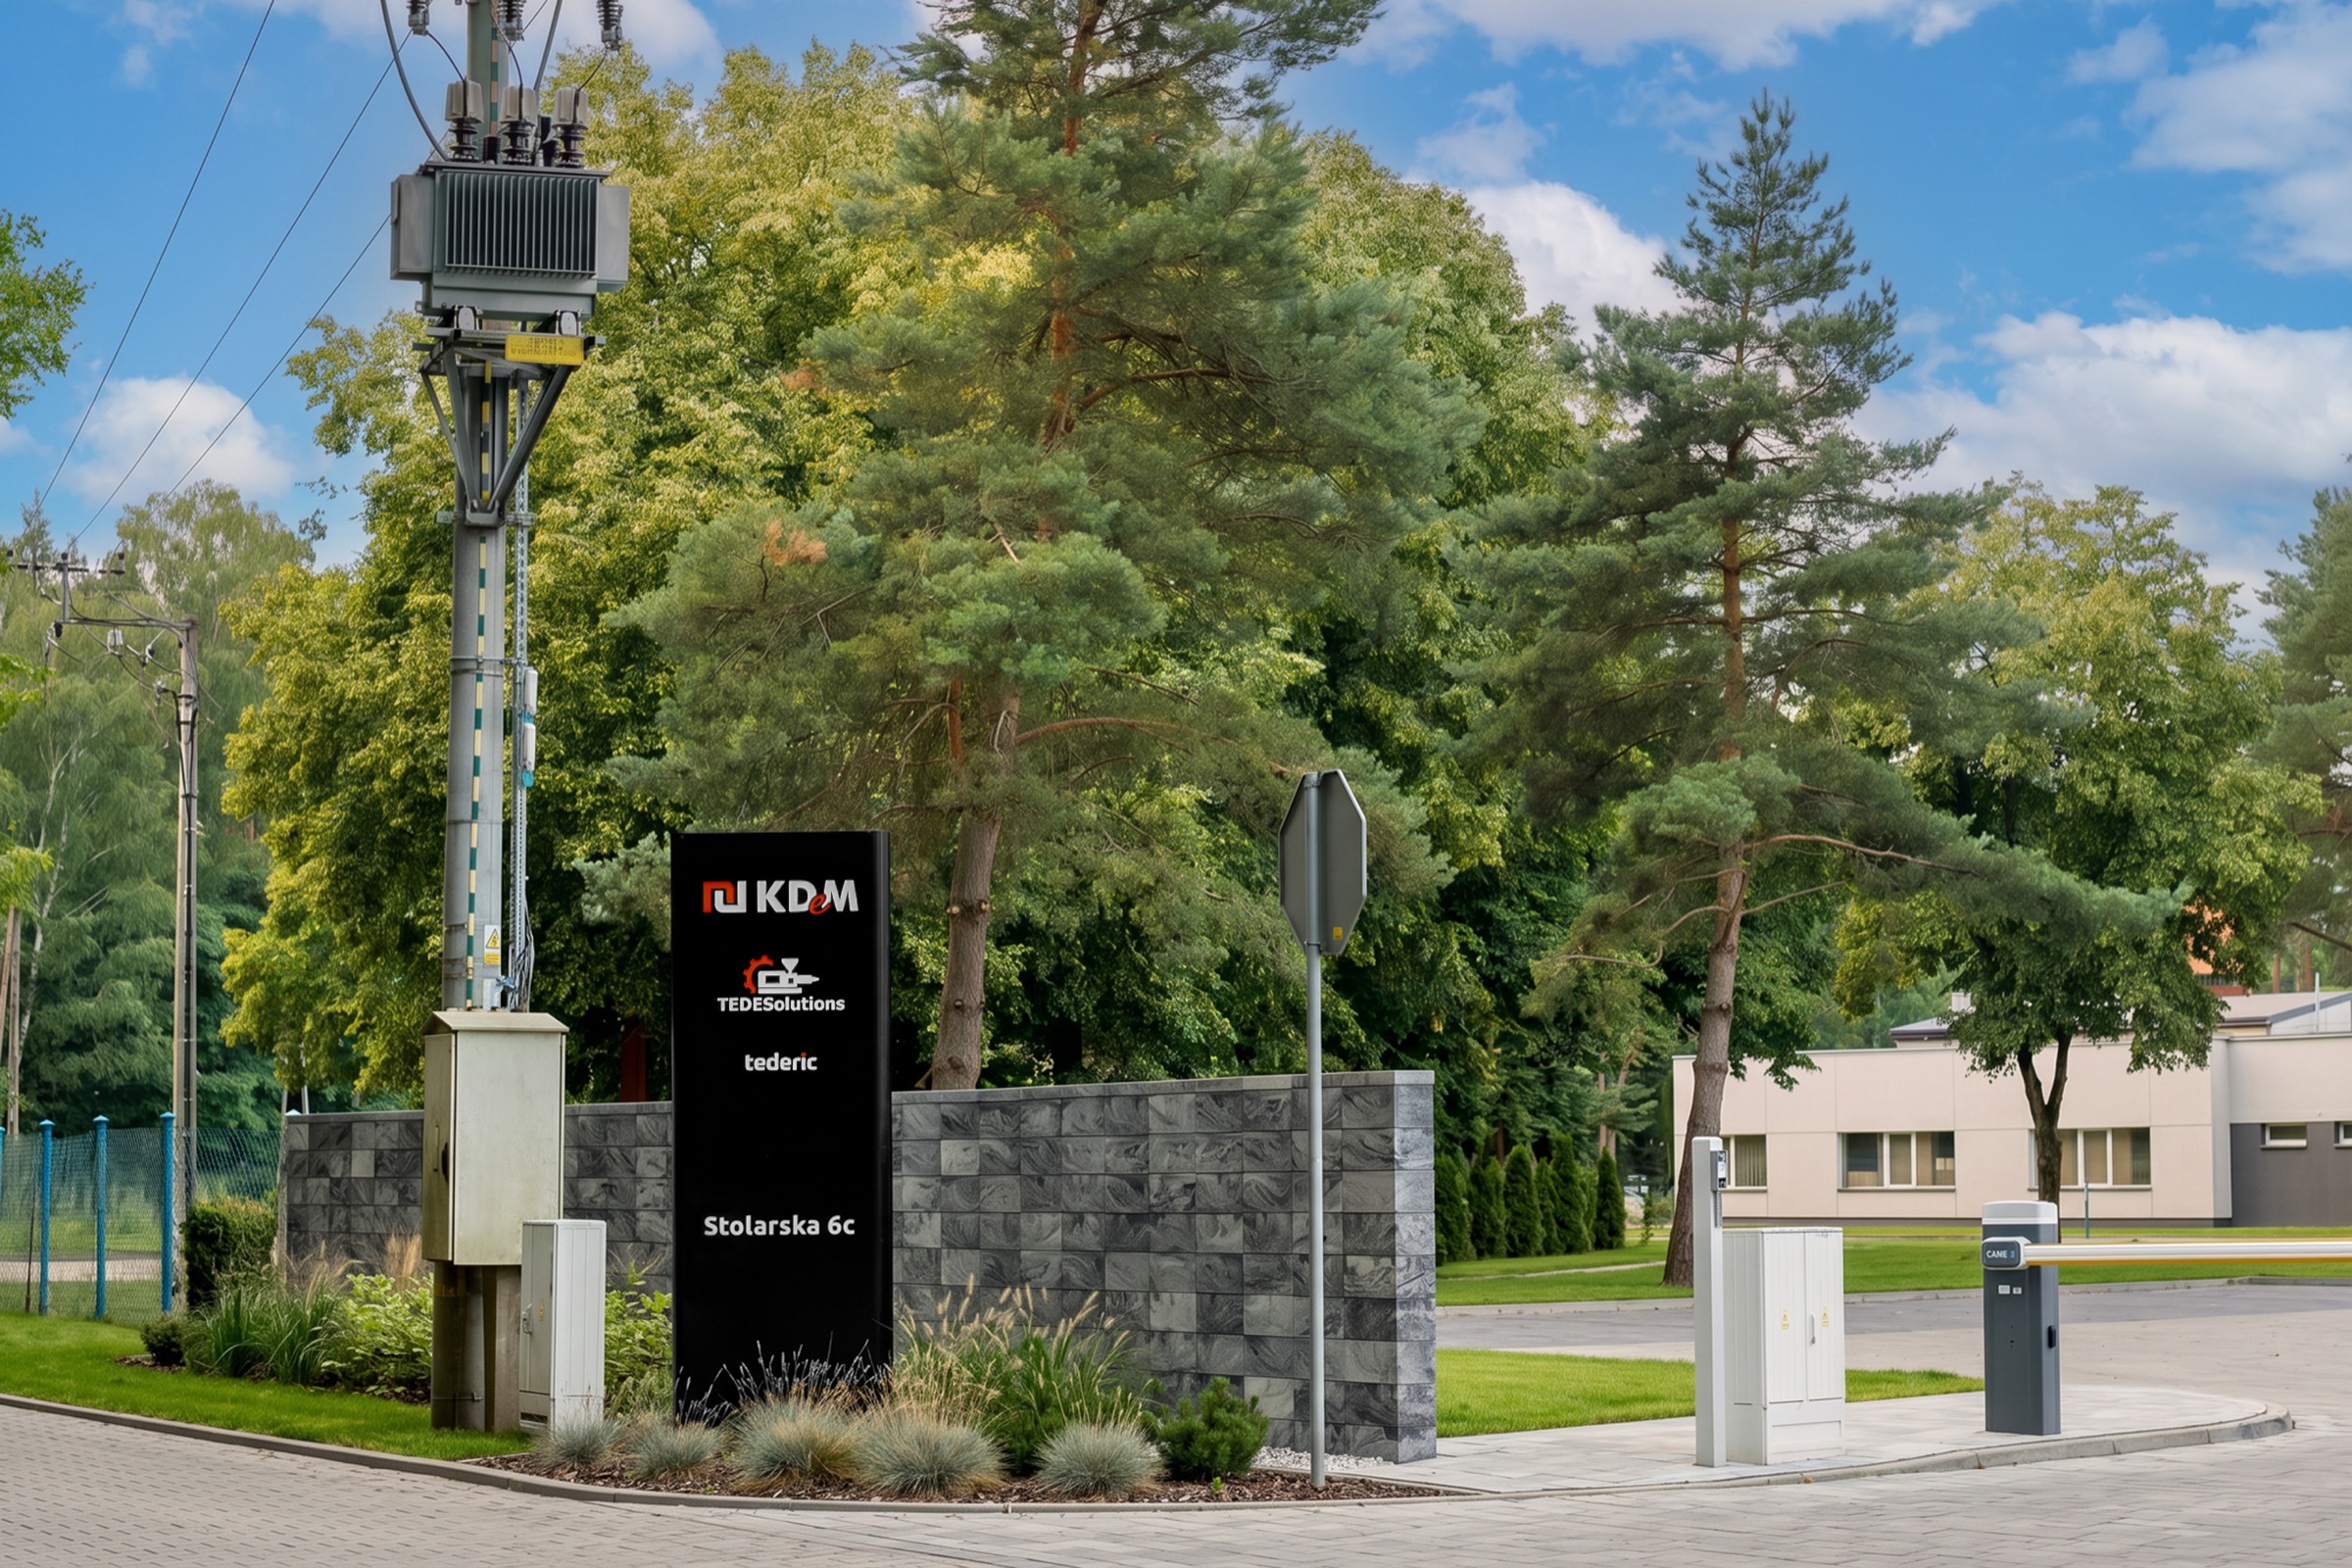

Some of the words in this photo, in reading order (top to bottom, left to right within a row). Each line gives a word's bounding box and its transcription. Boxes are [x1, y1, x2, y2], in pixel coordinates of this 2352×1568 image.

[716, 996, 846, 1012] TEDESolutions
[744, 1052, 818, 1072] tederic
[704, 1213, 821, 1237] Stolarska
[827, 1214, 856, 1236] 6c
